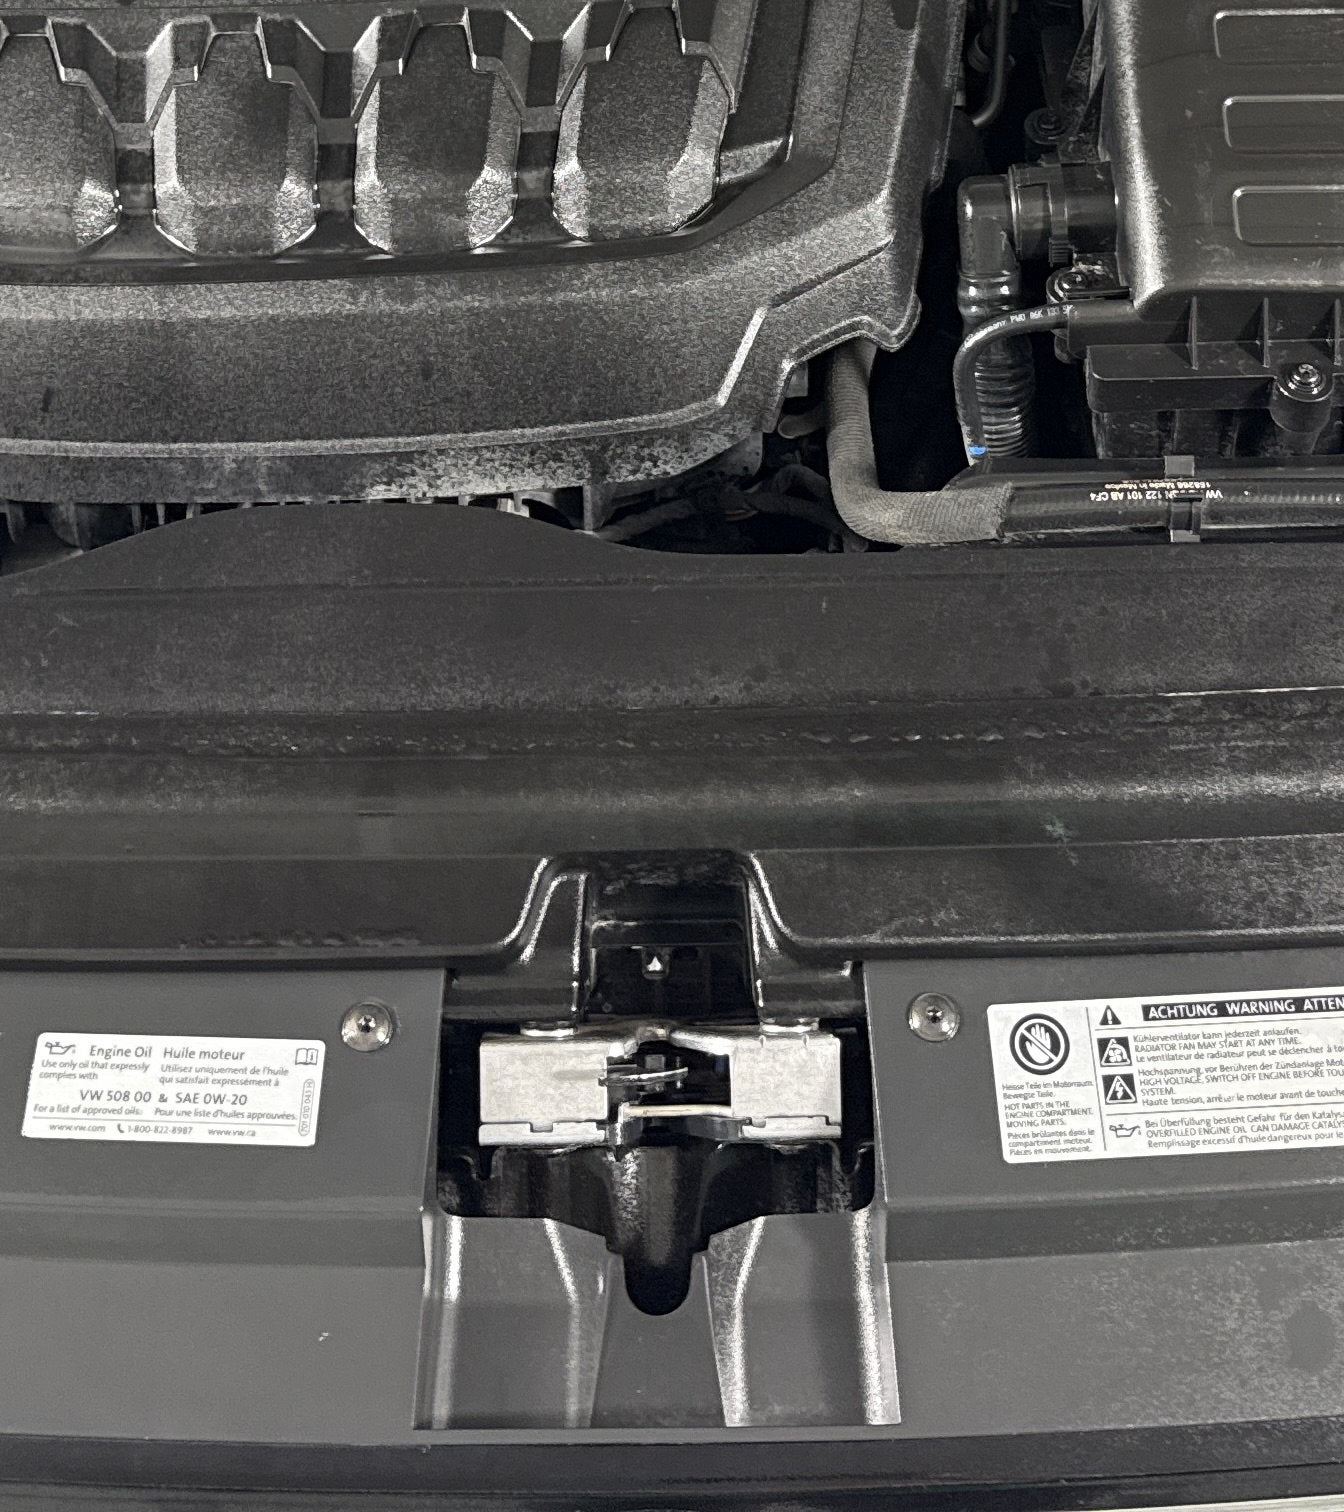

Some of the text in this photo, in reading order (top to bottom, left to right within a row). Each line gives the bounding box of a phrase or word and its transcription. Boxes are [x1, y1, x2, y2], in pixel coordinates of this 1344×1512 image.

[1127, 490, 1142, 500] 101
[1145, 490, 1162, 499] 122
[1147, 1003, 1218, 1019] ACHTUNG
[1225, 999, 1295, 1015] WARNING
[1132, 1031, 1201, 1043] Kühlerventilator
[1201, 1030, 1223, 1039] kann
[1133, 1036, 1301, 1053] RADIATOR FAN MAY START AT ANY TIME.
[88, 1044, 245, 1060] Engine Oil Huile moteur
[1146, 1052, 1192, 1062] ventilateur
[1193, 1051, 1204, 1059] de
[1206, 1049, 1245, 1059] radiateur
[1245, 1048, 1267, 1058] peut
[40, 1059, 150, 1073] Use only oil that expressly
[160, 1063, 289, 1076] Utilisez uniquement de l'huile
[1203, 1065, 1218, 1073] vor
[1258, 1062, 1273, 1070] der
[78, 1071, 99, 1080] with
[1138, 1077, 1162, 1087] HIGH
[1204, 1073, 1238, 1083] SWITCH
[1240, 1072, 1257, 1081] OFF
[1257, 1071, 1291, 1080] ENGINE
[1292, 1069, 1325, 1078] BEFORE
[78, 1089, 248, 1105] VW 508 00 & SAE 0W-20
[1140, 1086, 1176, 1096] SYSTEM.
[1141, 1097, 1168, 1106] Haute
[1246, 1091, 1277, 1100] moteur
[1279, 1090, 1303, 1099] avant
[1303, 1089, 1315, 1097] de
[33, 1103, 123, 1116] For list of approved
[1003, 1102, 1020, 1111] HOT
[1021, 1101, 1044, 1110] PARTS
[1055, 1100, 1070, 1108] THE
[153, 1107, 173, 1116] Pour
[193, 1108, 211, 1117] liste
[212, 1109, 245, 1118] d'huiles
[1213, 1114, 1245, 1124] besteht
[1246, 1113, 1276, 1122] Gefahr
[1279, 1112, 1293, 1120] für
[1293, 1111, 1310, 1120] den
[126, 1125, 193, 1135] 1-800-822-8987
[1005, 1119, 1039, 1128] MOVING
[1145, 1127, 1196, 1138] OVERFILLED
[1197, 1126, 1231, 1135] ENGINE
[1249, 1123, 1269, 1133] CAN
[1270, 1121, 1310, 1131] DAMAGE
[1147, 1138, 1201, 1150] Remplissage
[1201, 1136, 1236, 1146] excessif
[1266, 1132, 1312, 1144] dangereux
[1313, 1131, 1334, 1141] pour
